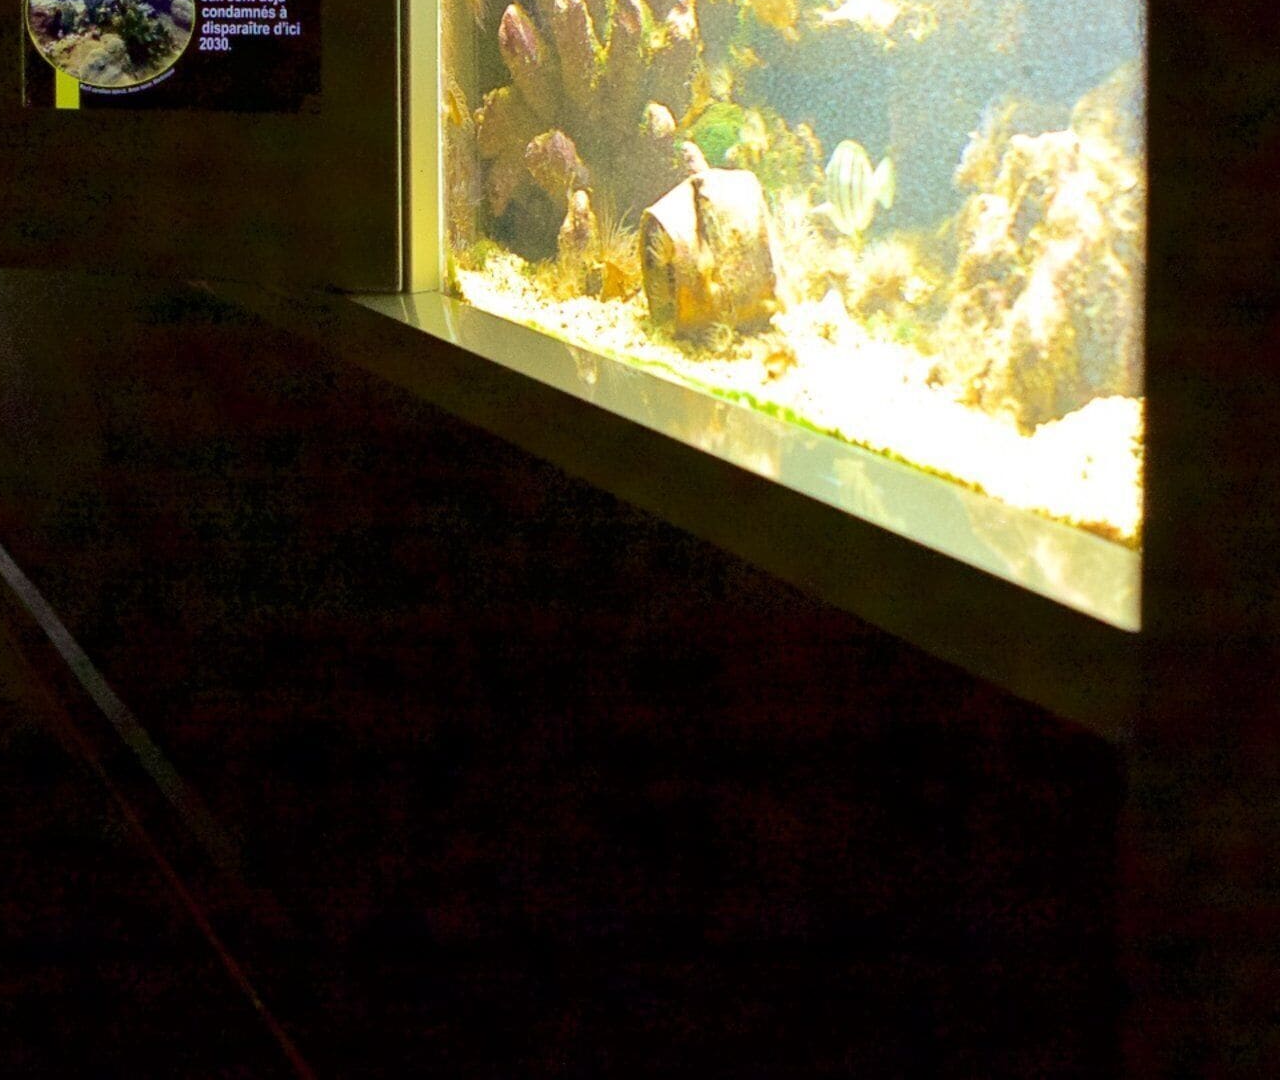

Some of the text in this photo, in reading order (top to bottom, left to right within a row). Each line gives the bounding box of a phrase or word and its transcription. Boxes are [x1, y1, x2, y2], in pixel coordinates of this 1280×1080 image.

[202, 5, 276, 18] condamnés
[202, 20, 300, 38] disparaître d'ici
[199, 37, 231, 51] 2030.
